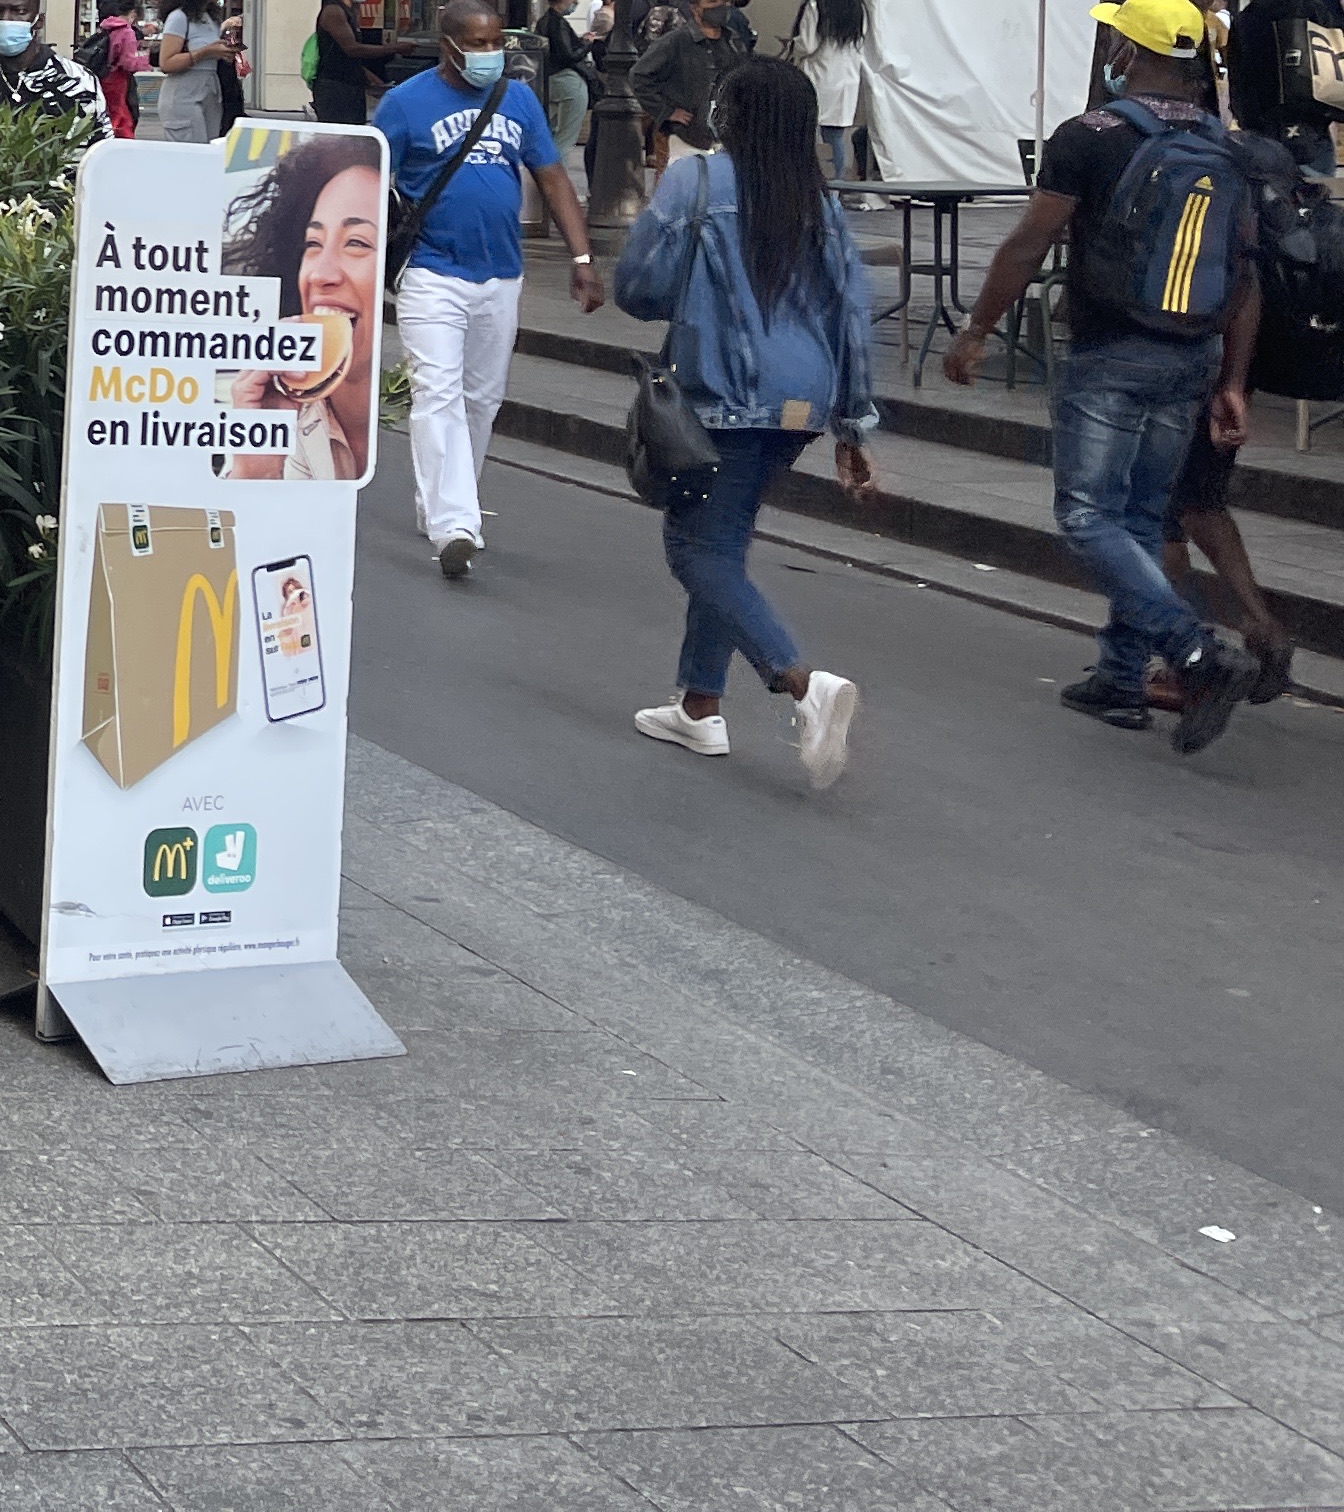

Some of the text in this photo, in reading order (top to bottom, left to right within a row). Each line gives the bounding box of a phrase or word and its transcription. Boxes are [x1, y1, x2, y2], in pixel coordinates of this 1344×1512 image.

[96, 221, 210, 274] À tout
[94, 284, 262, 323] moment,
[91, 326, 317, 362] commandez
[88, 365, 200, 405] McDo
[87, 410, 291, 449] en livraison
[181, 794, 225, 812] AVEC
[207, 873, 252, 885] deliveroo
